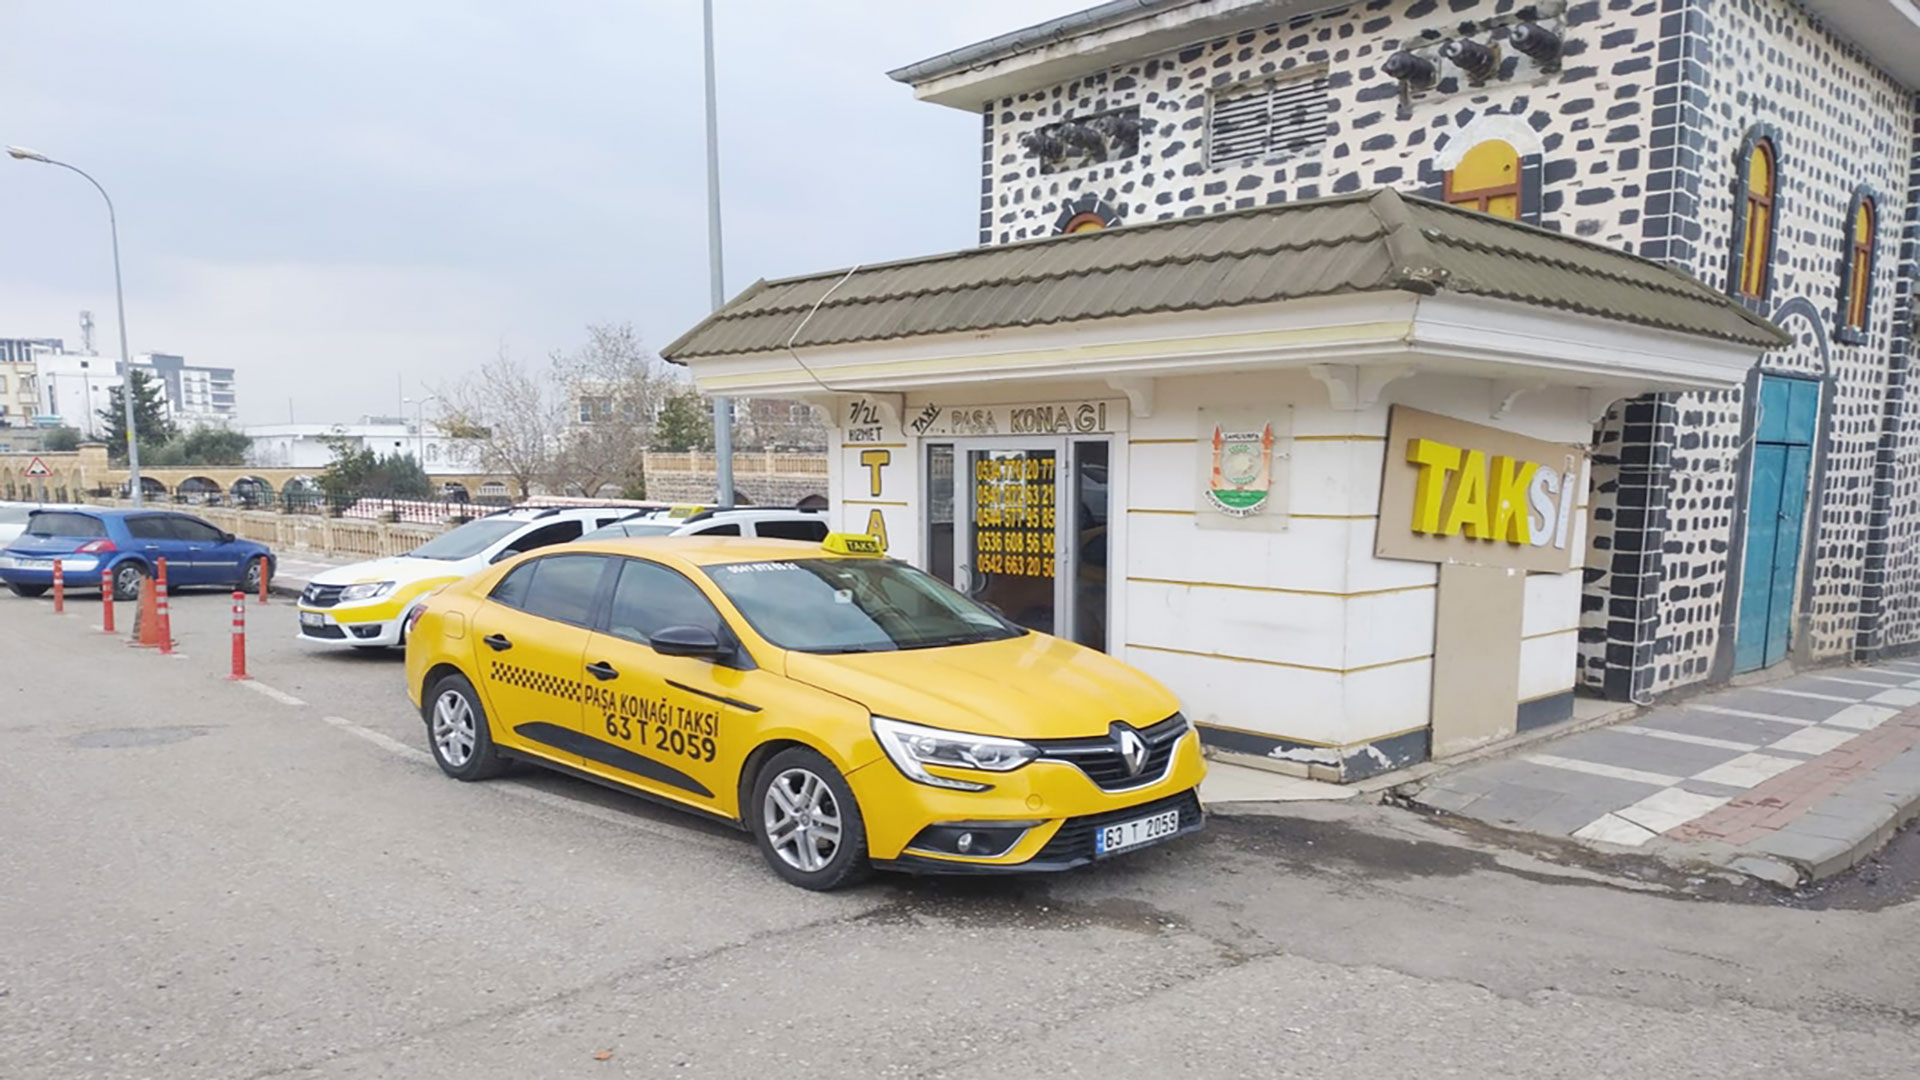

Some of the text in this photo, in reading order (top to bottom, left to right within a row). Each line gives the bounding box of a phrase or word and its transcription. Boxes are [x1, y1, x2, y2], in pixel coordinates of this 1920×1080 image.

[1042, 484, 1055, 505] 21
[978, 555, 1002, 573] 0542
[1026, 556, 1040, 576] 20
[585, 685, 719, 737] PAŞA KONAĞI TAKSİ
[606, 713, 716, 762] 63 T 2059
[1106, 813, 1176, 848] 63 T 2059
